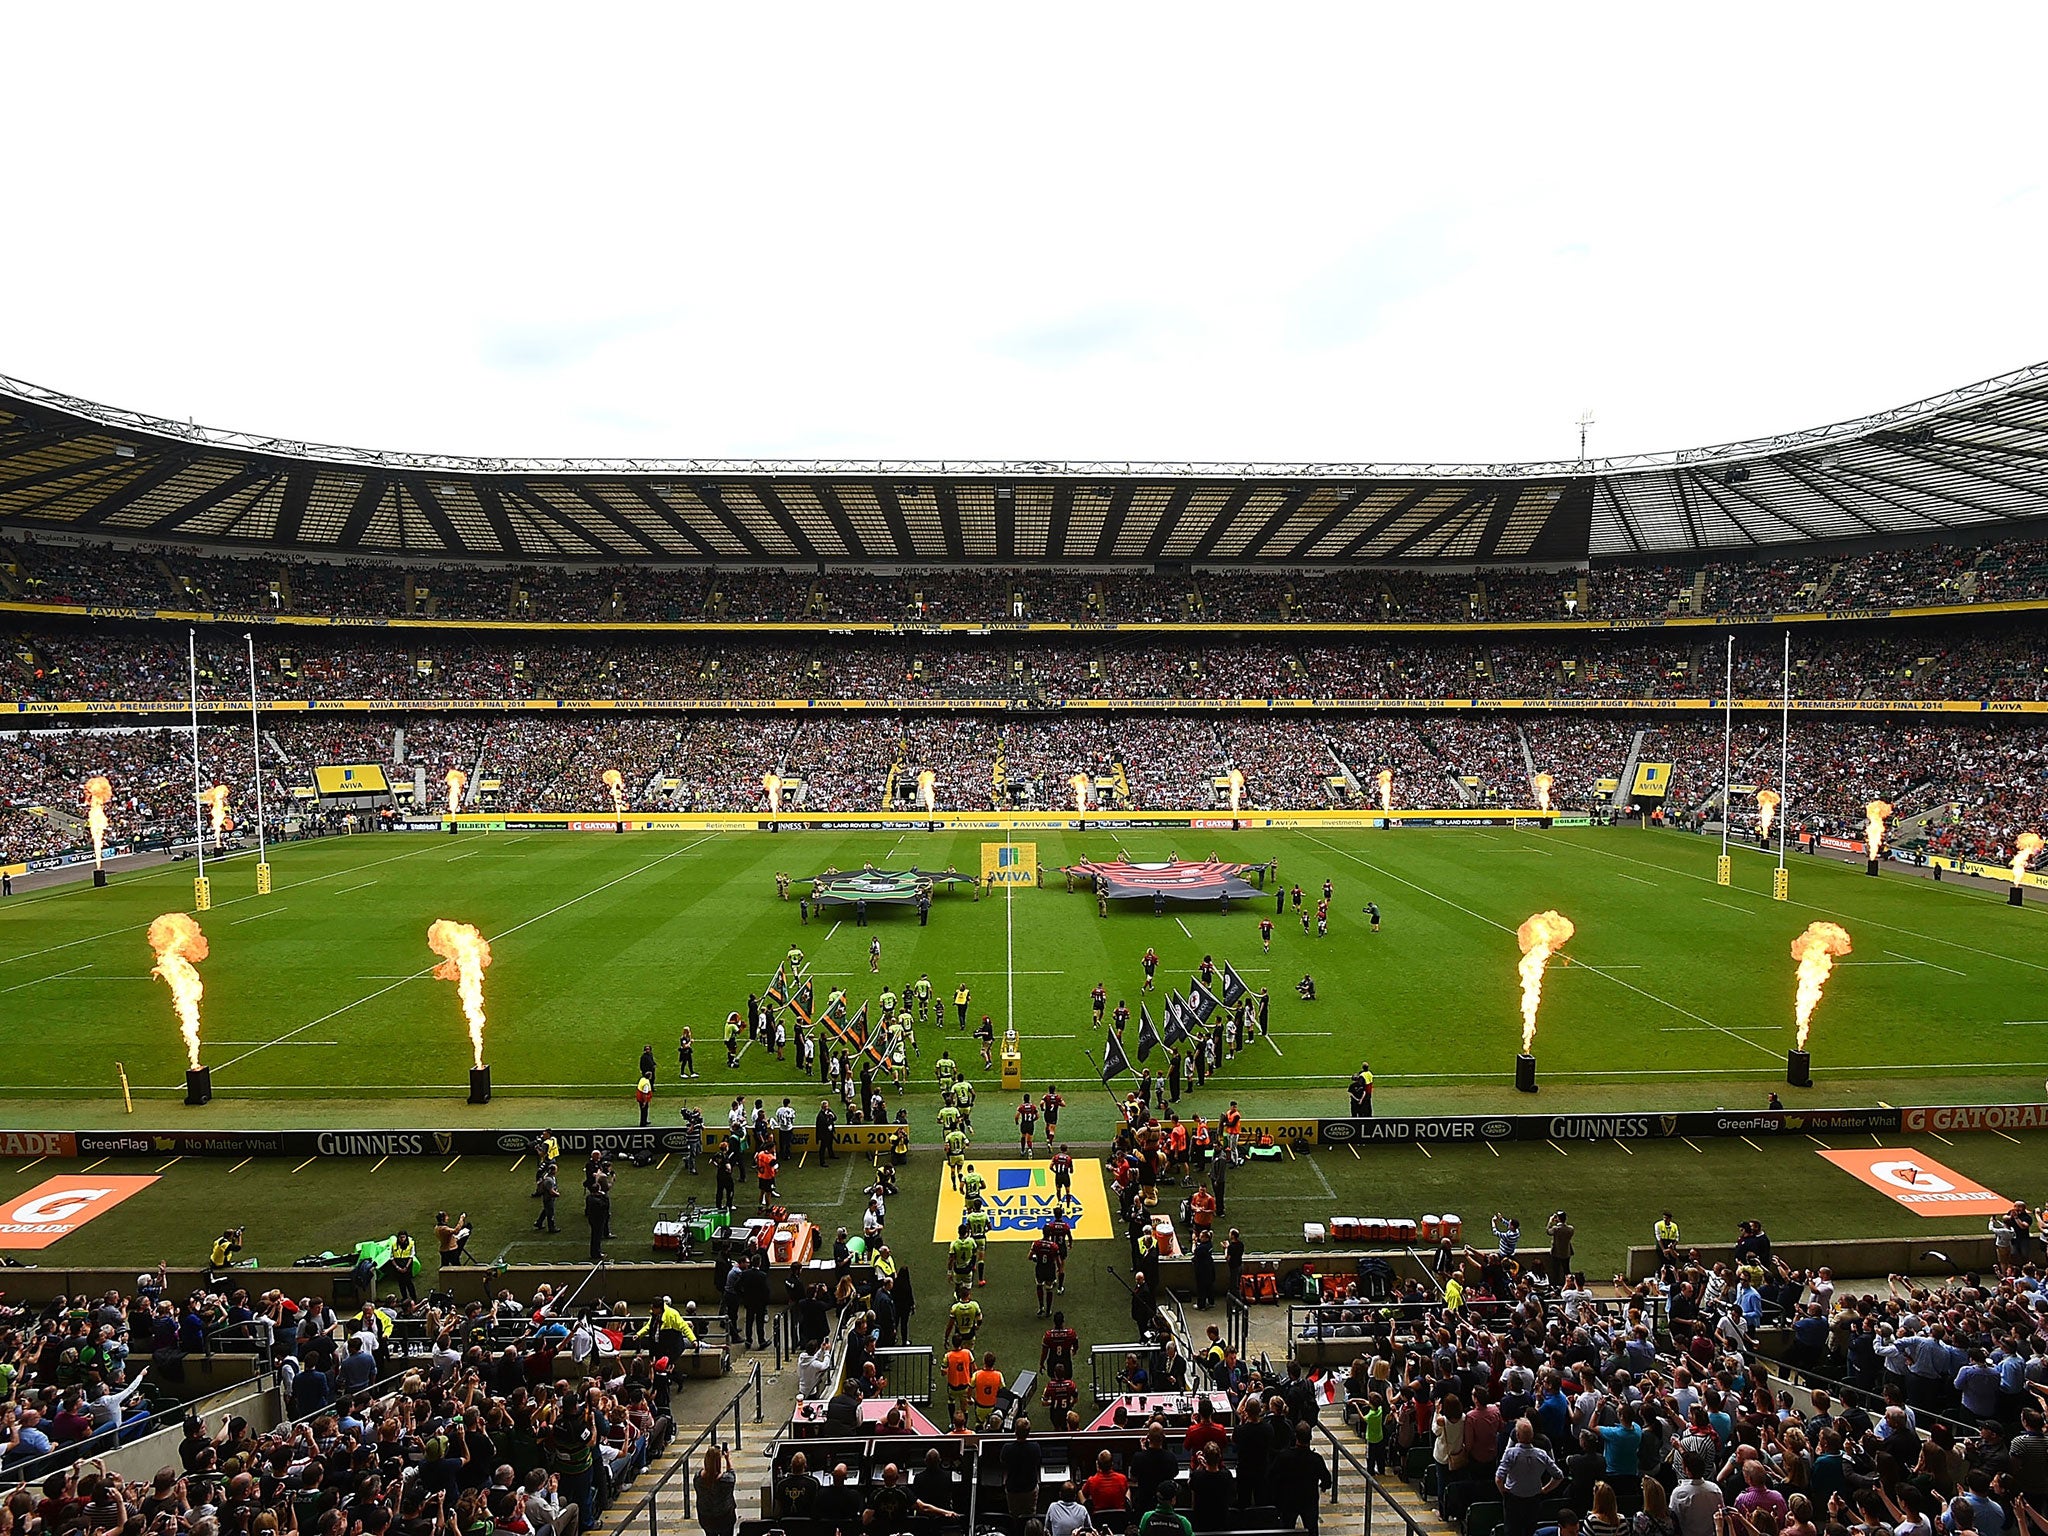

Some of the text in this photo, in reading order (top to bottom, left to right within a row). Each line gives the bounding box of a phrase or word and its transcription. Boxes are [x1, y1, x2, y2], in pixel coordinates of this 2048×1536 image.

[96, 608, 134, 618] AVIVA
[1835, 610, 1870, 620] AVIVA
[42, 859, 60, 868] Sport
[1717, 1117, 1779, 1130] GreenFlag
[1812, 1115, 1896, 1127] No Matter What
[1907, 1108, 1926, 1130] G
[1278, 1126, 1314, 1138] 2014
[1361, 1122, 1475, 1139] LAND ROVER
[1549, 1116, 1648, 1138] GUINNESS
[0, 1134, 62, 1154] ADE
[82, 1137, 148, 1151] GreenFlag
[185, 1138, 277, 1150] No Matter What
[318, 1132, 423, 1156] GUINNESS
[593, 1134, 656, 1149] ROVER
[1870, 1160, 1956, 1192] G
[979, 1194, 1082, 1206] AVIVA
[1896, 1192, 1998, 1203] GATORADE
[11, 1188, 113, 1223] G
[961, 1317, 971, 1328] 12
